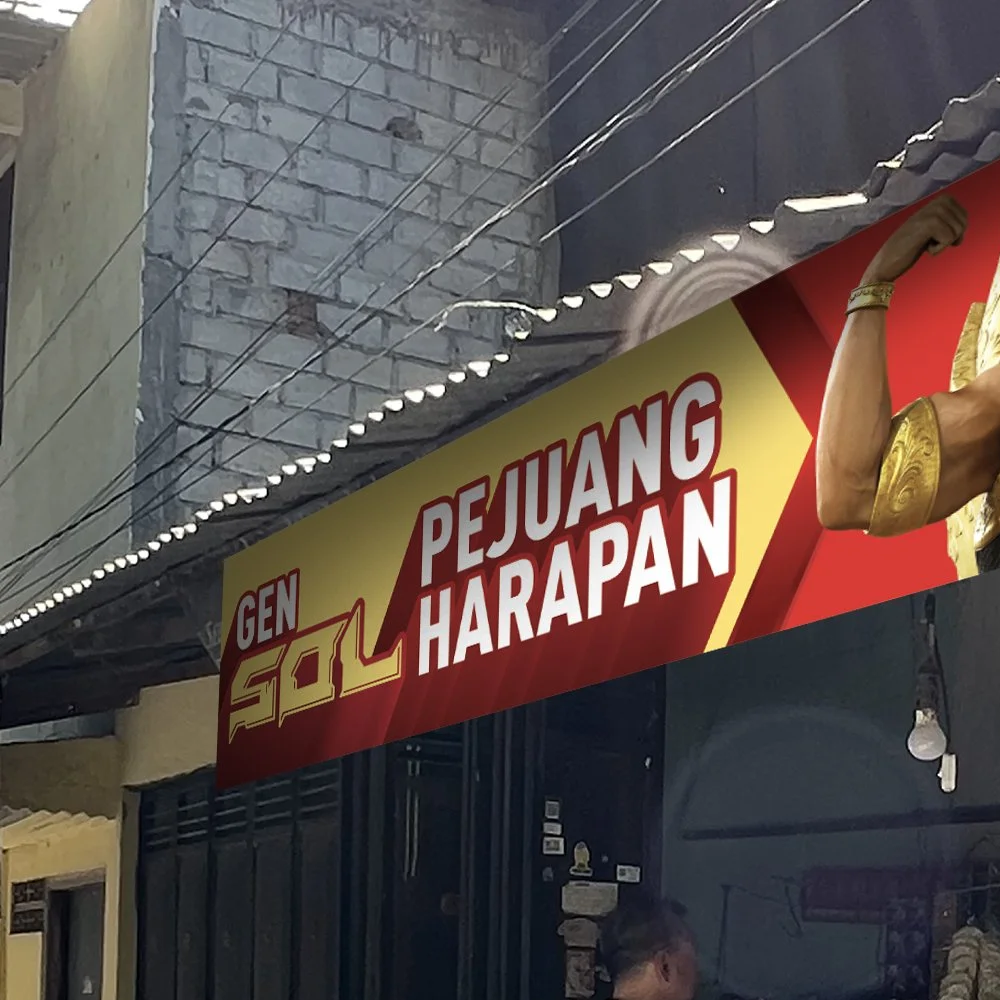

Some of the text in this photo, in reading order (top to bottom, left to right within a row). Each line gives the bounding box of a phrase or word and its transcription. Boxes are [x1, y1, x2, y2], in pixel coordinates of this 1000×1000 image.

[420, 379, 718, 588] PEJUANG
[236, 572, 299, 652] GEN
[417, 479, 731, 675] HARAPAN
[229, 607, 402, 743] SOL
